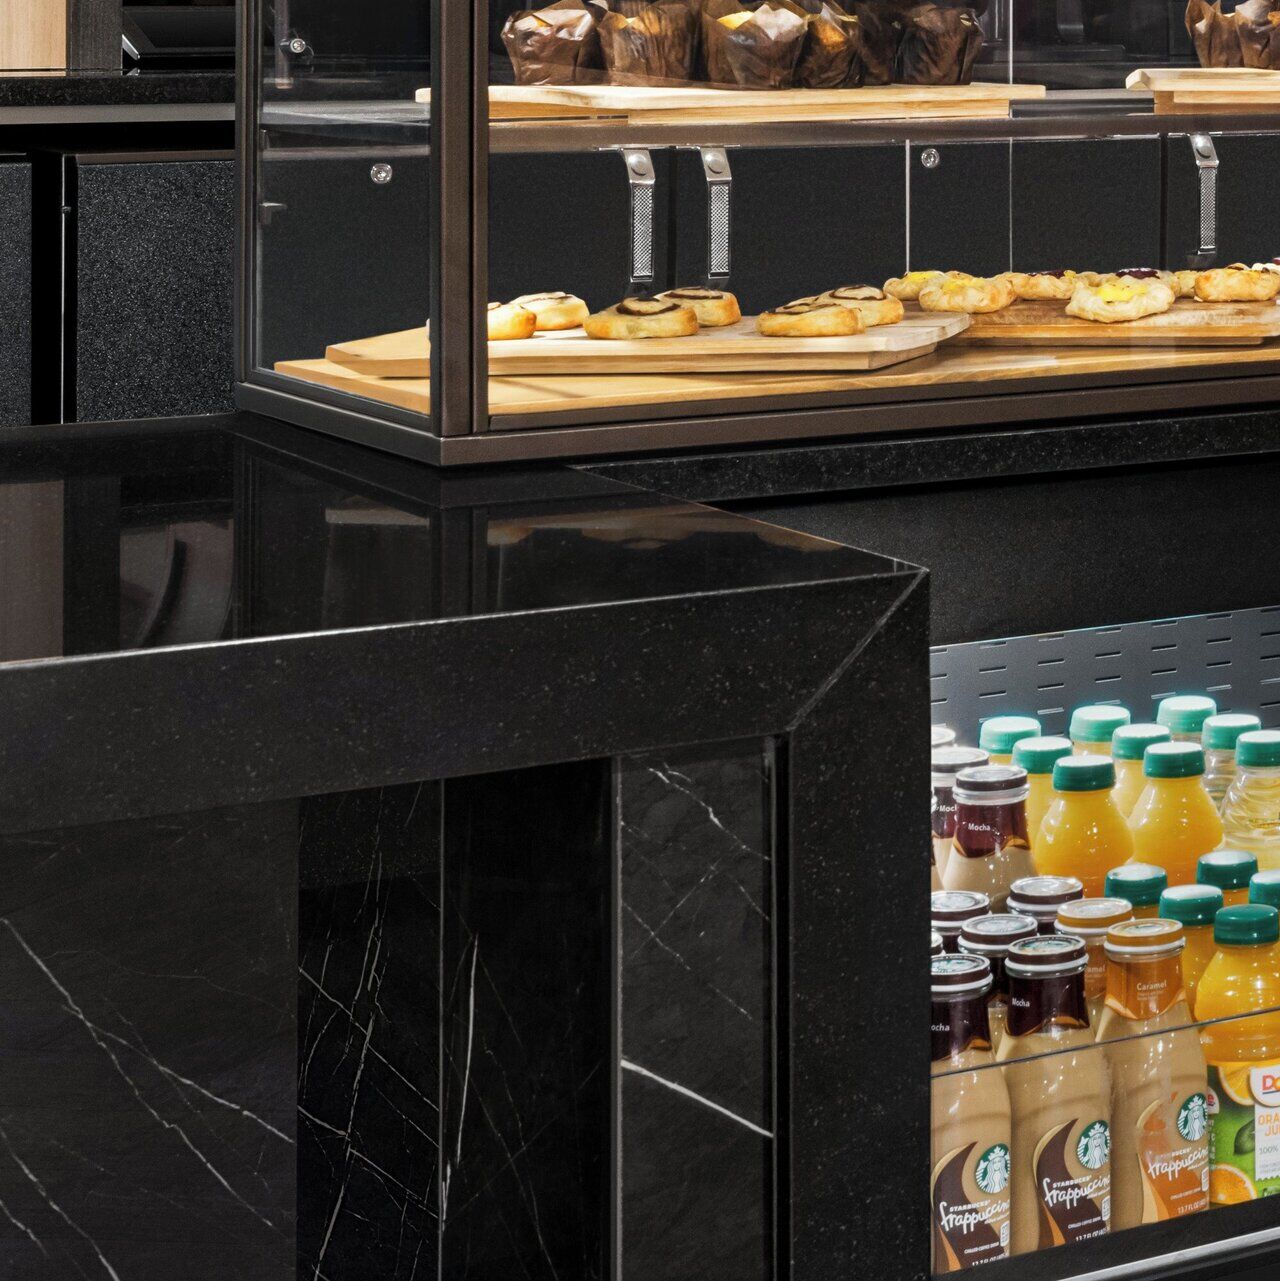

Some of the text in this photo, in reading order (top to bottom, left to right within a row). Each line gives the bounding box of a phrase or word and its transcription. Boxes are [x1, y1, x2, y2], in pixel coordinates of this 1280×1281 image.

[968, 823, 991, 831] Mocha
[1136, 979, 1167, 991] Caramel
[1012, 997, 1031, 1008] Mocha
[930, 1023, 950, 1032] ocha
[1259, 1144, 1279, 1155] 100%
[1053, 1175, 1091, 1188] STARBUCKS
[950, 1200, 989, 1212] STARBUCKS
